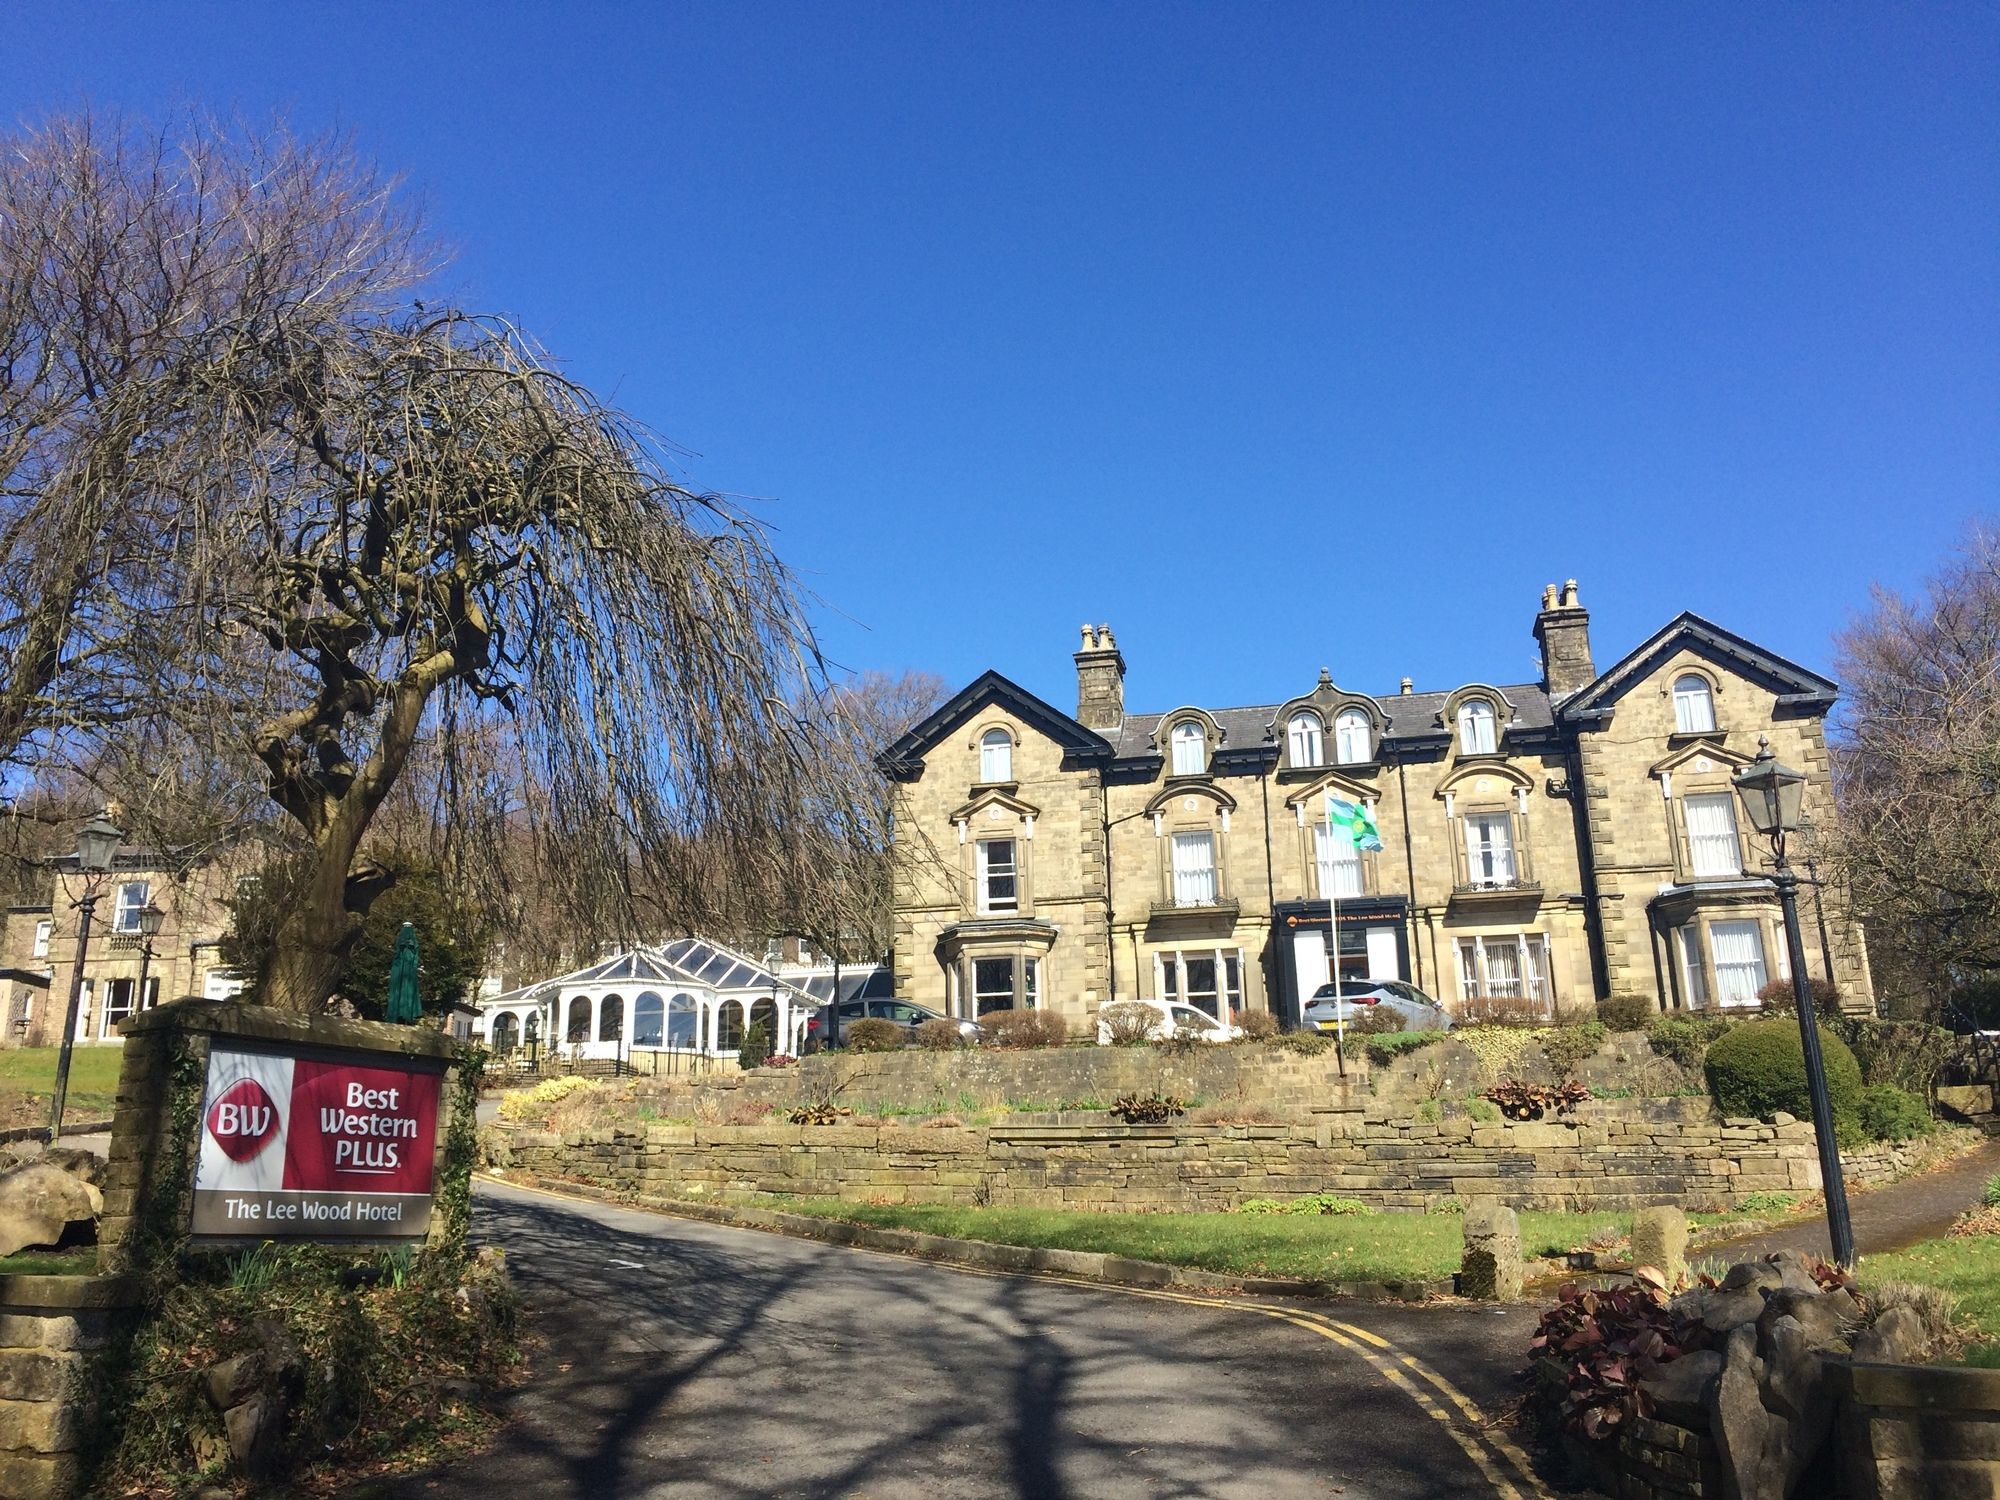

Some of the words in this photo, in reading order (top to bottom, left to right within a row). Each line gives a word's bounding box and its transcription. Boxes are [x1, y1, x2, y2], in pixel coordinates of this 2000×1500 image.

[346, 1082, 399, 1110] Best
[216, 1103, 270, 1136] BW
[320, 1107, 418, 1138] Western
[225, 1198, 261, 1219] The
[266, 1200, 296, 1219] Lee
[302, 1200, 351, 1220] Wood
[356, 1201, 402, 1221] Hotel
